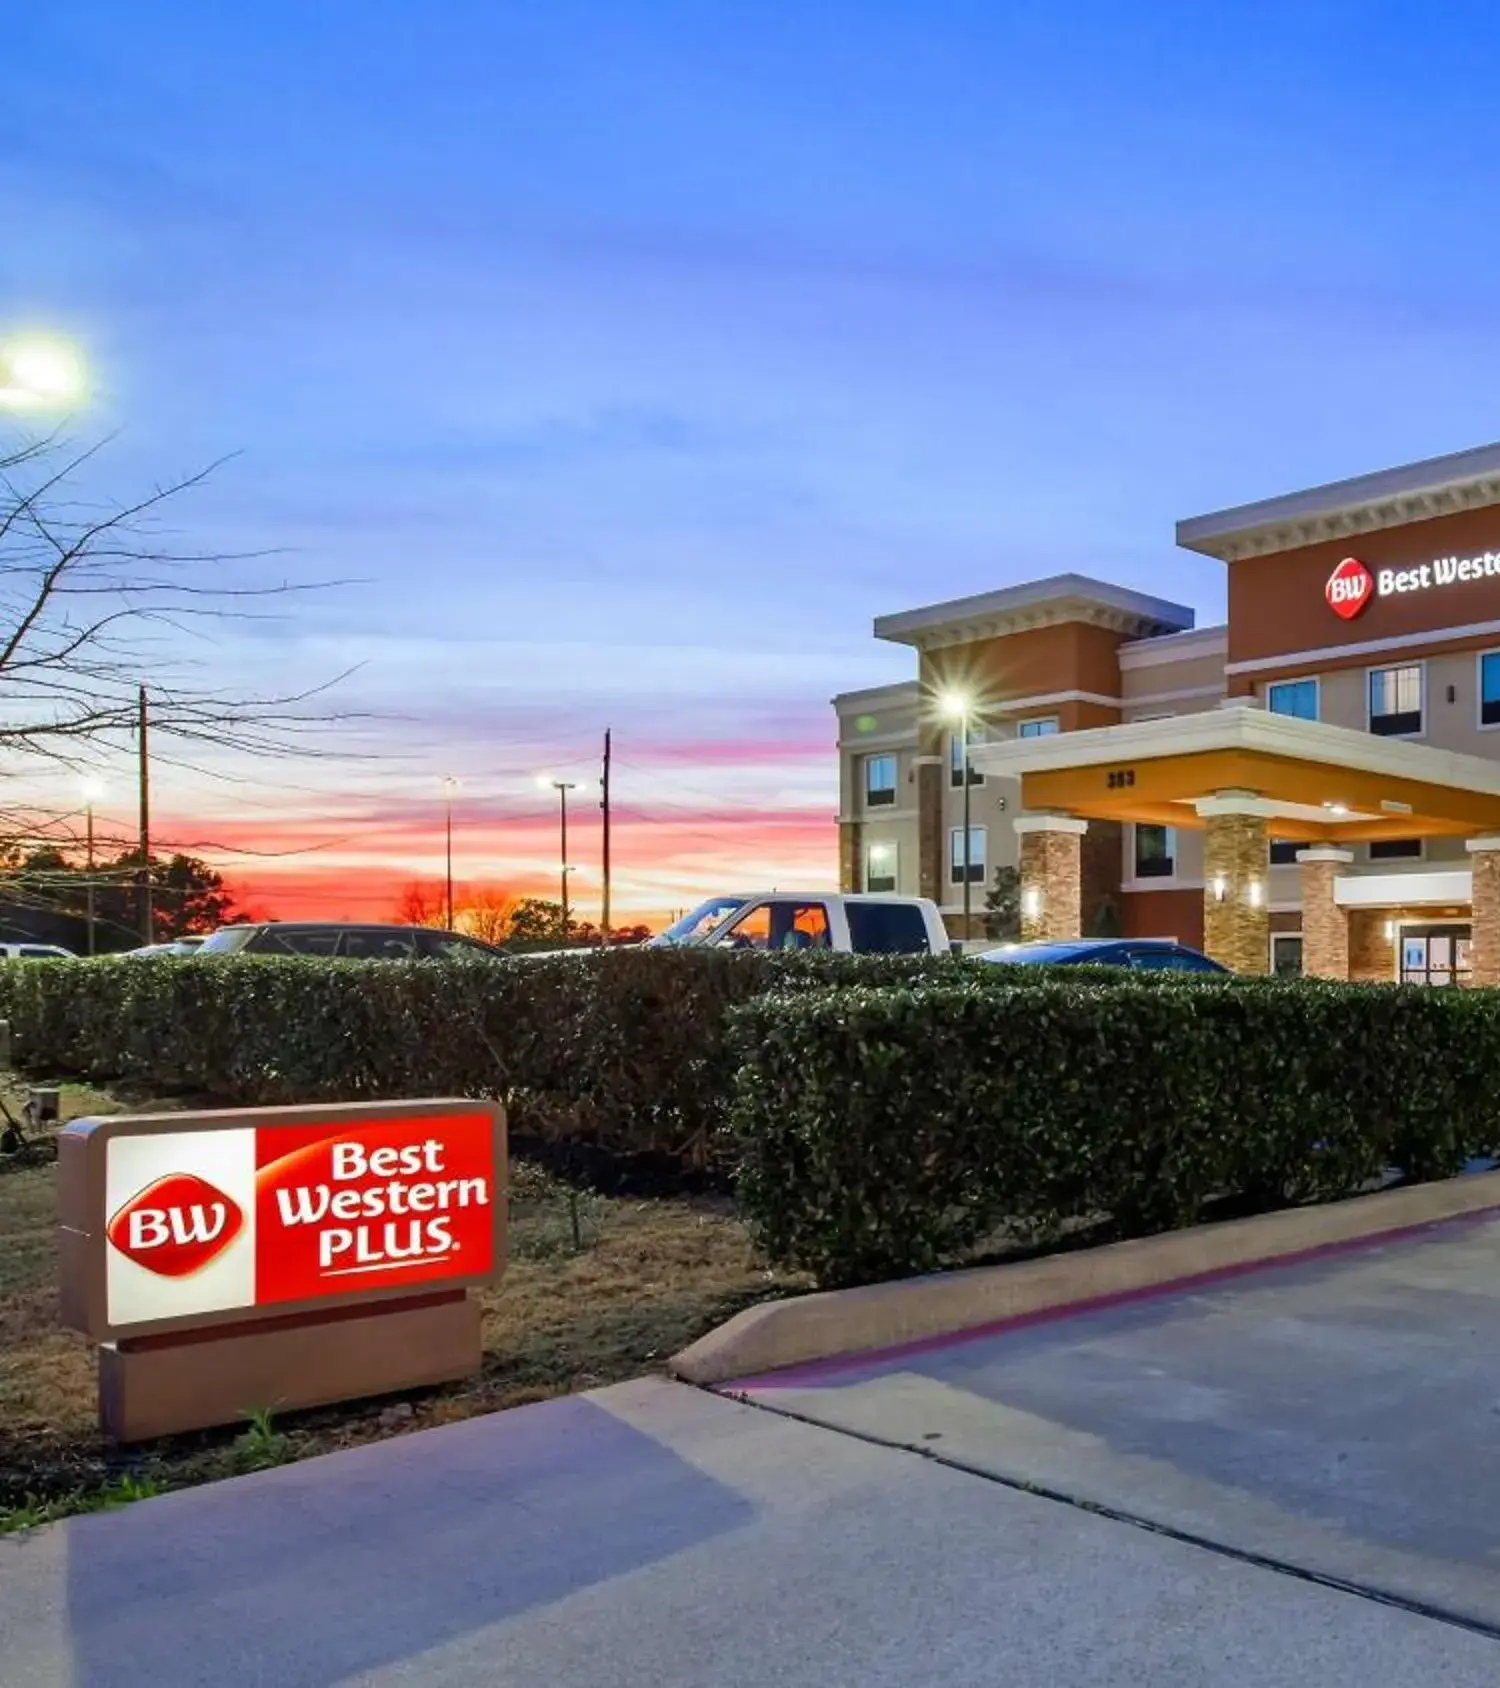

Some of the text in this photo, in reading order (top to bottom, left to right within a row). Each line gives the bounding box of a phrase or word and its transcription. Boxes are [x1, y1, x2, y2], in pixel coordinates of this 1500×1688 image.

[1330, 574, 1367, 603] BW
[1378, 564, 1431, 596] Best
[332, 1139, 445, 1181] Best
[277, 1177, 488, 1226] Western
[129, 1203, 225, 1249] BW
